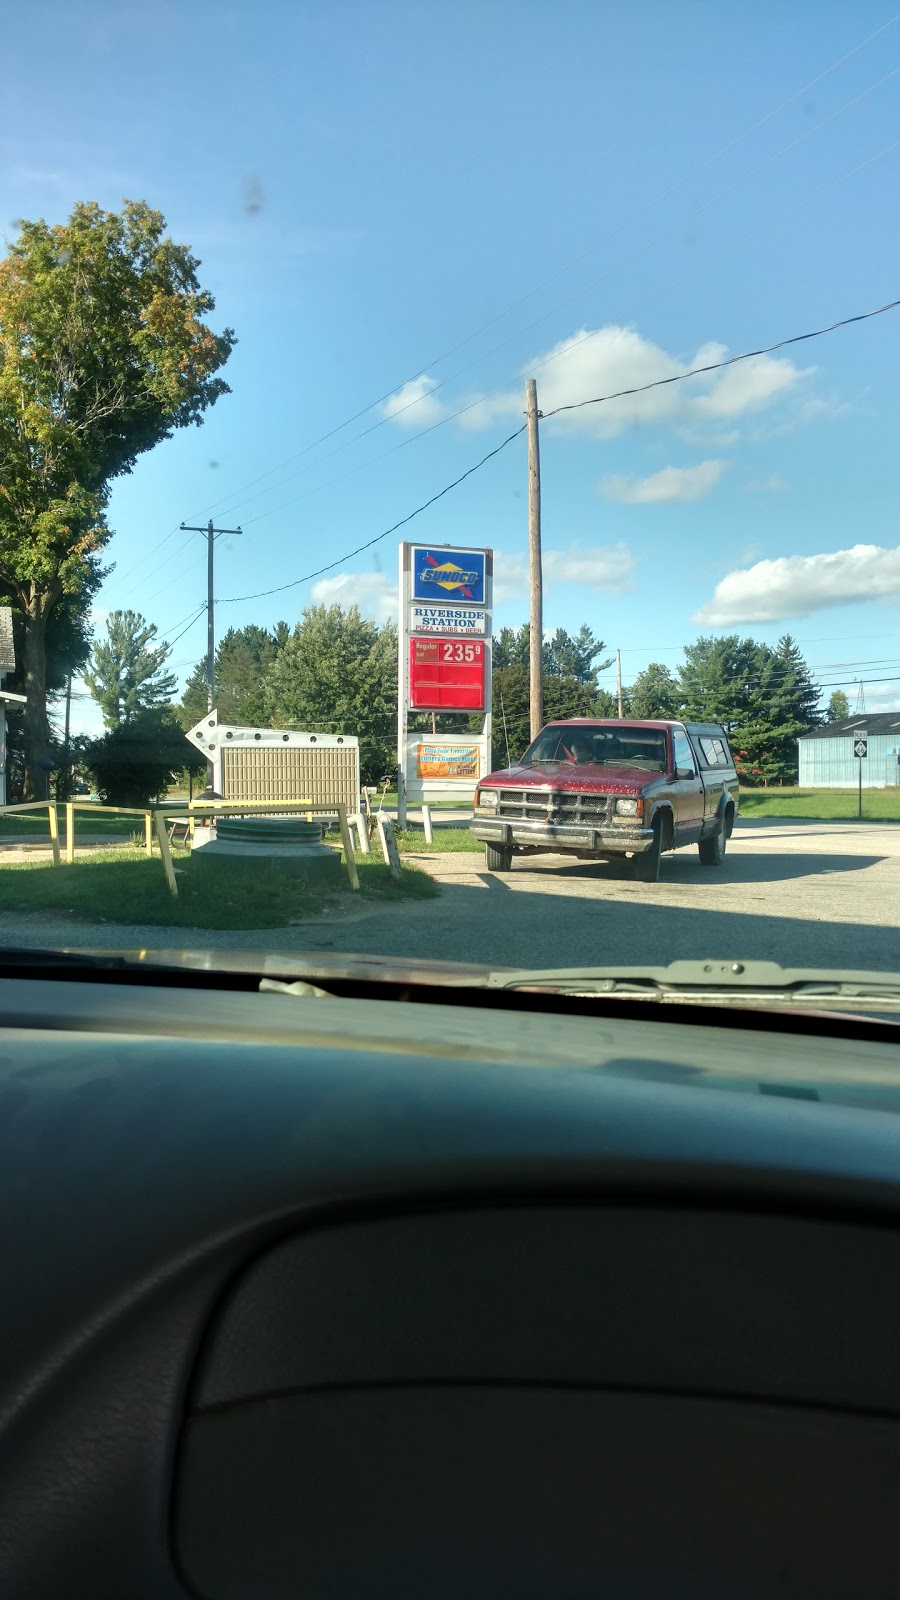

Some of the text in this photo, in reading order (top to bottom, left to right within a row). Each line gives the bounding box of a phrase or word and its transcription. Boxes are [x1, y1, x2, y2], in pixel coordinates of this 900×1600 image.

[422, 568, 477, 585] SUNOCO
[414, 608, 484, 619] RIVERSIDE
[422, 617, 476, 627] STATION
